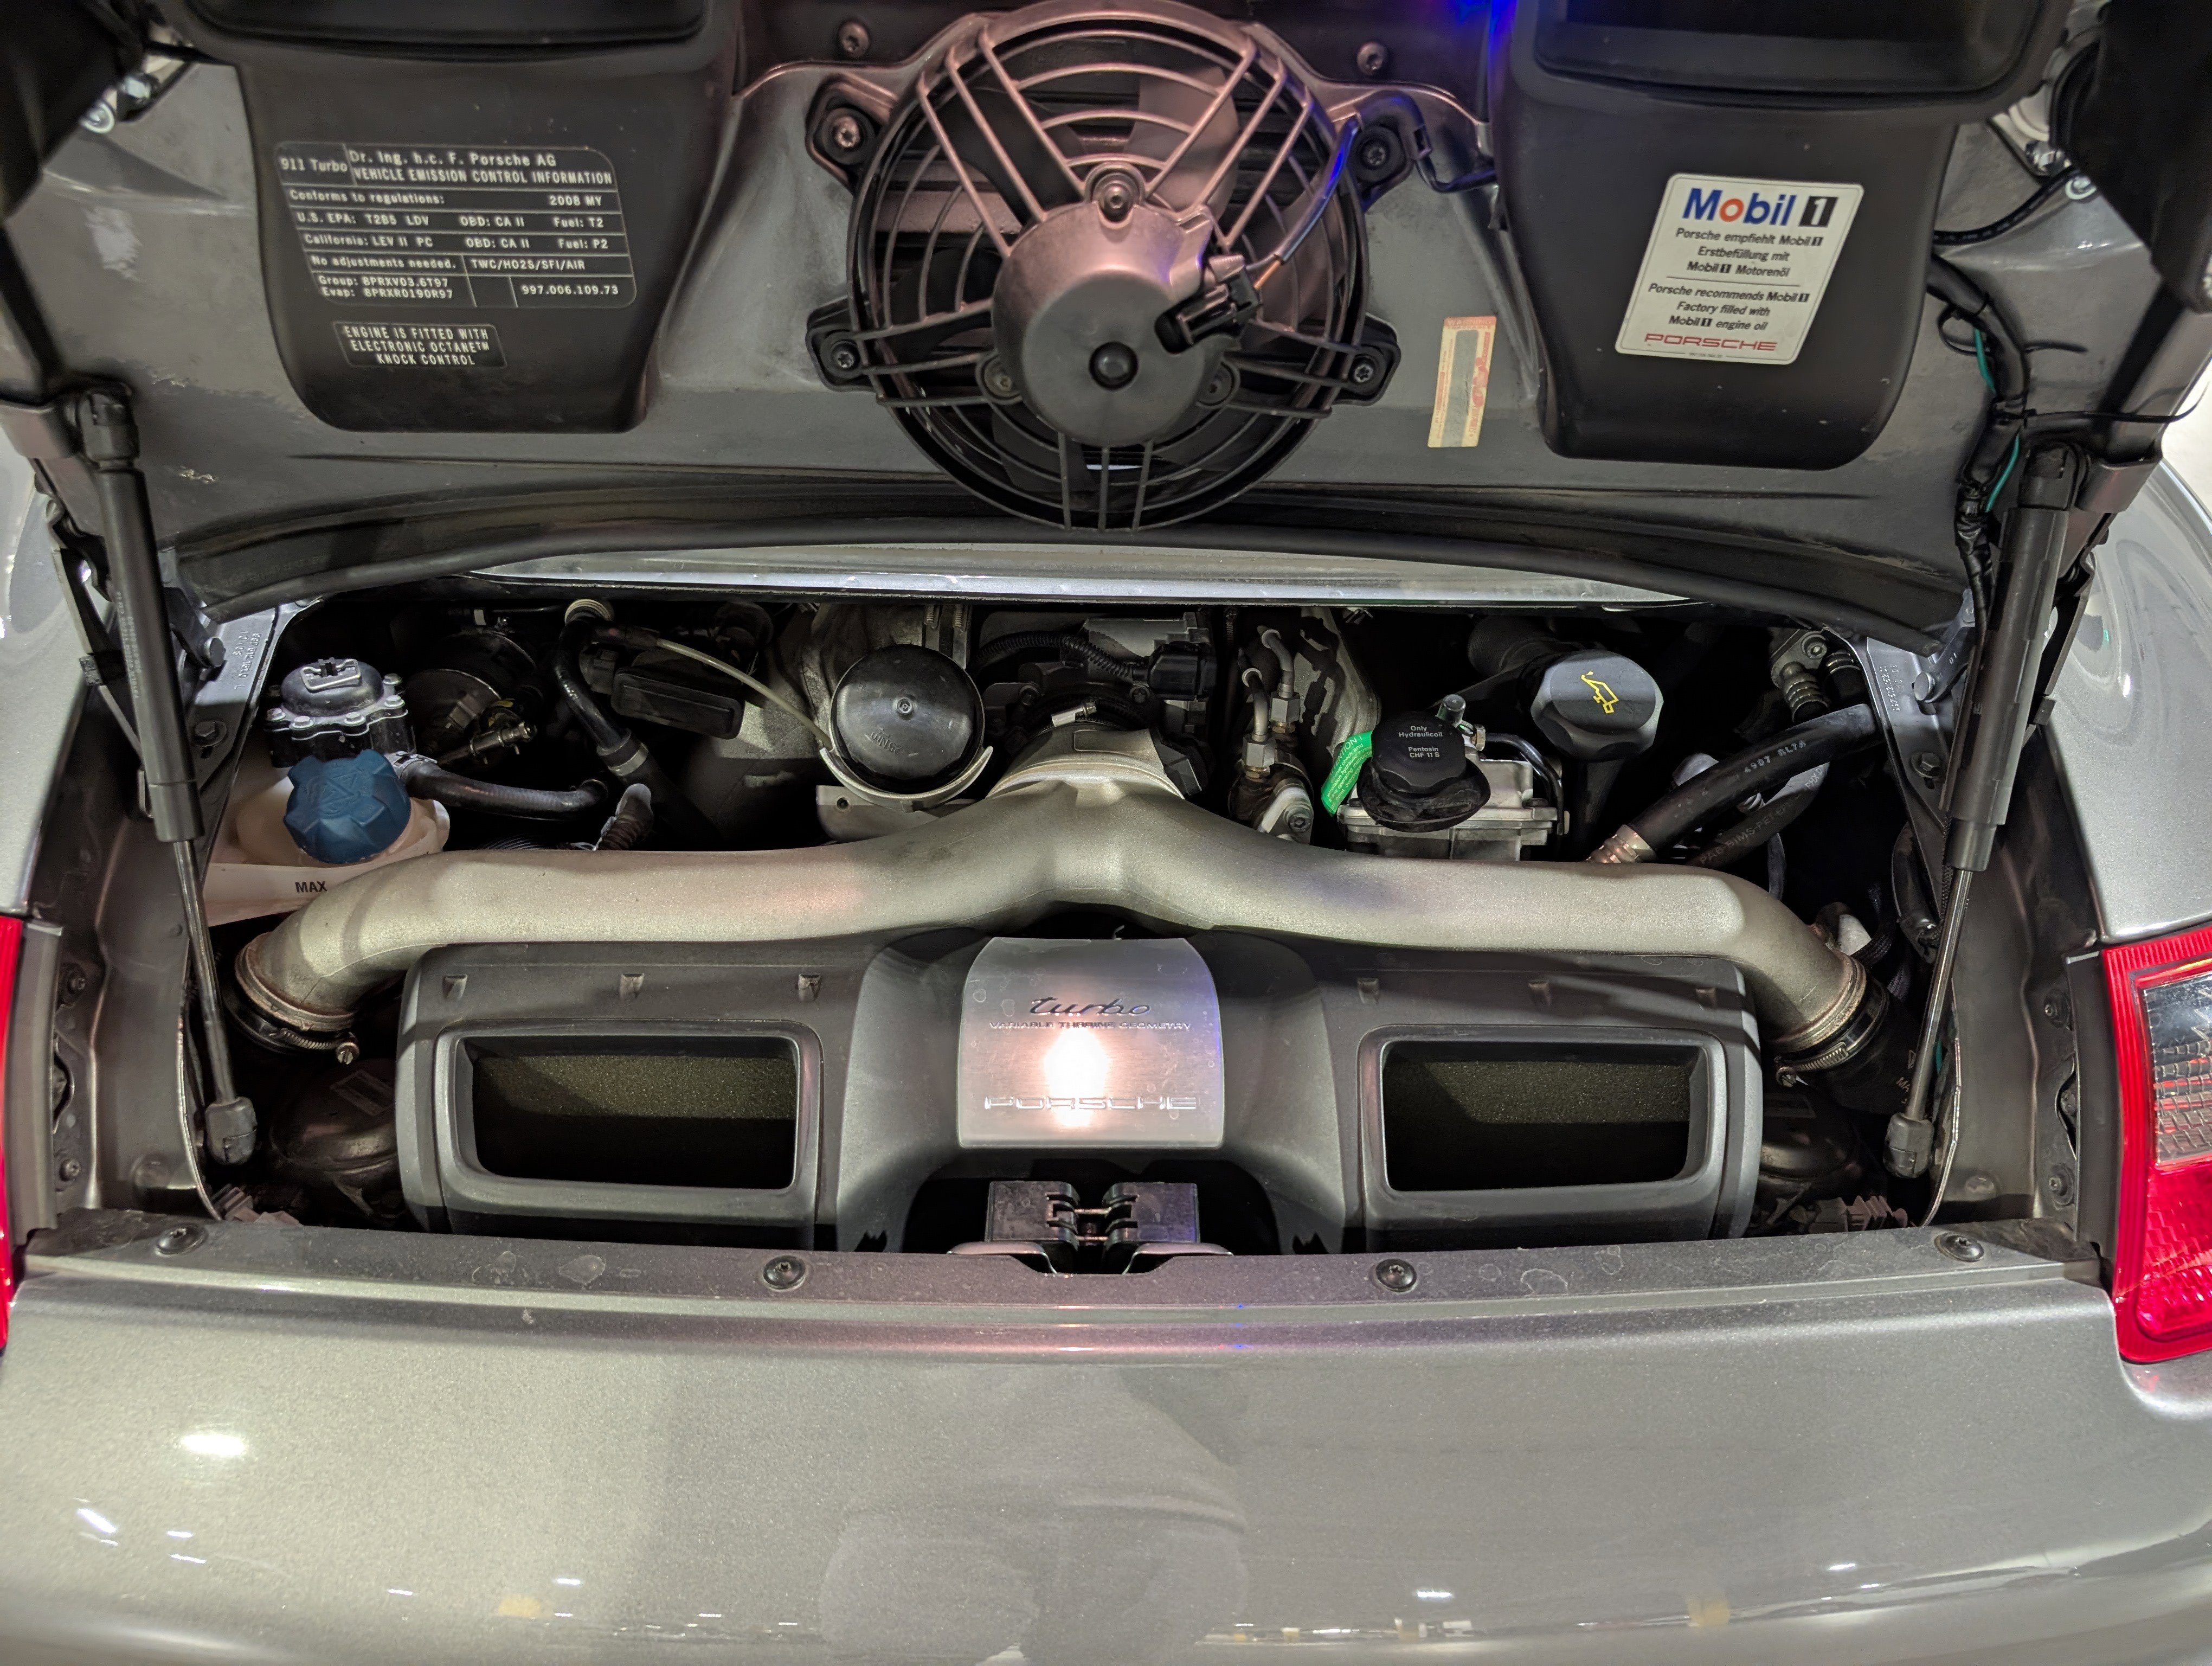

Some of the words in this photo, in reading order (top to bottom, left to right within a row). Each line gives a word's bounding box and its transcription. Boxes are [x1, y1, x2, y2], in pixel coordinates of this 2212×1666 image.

[280, 157, 306, 171] 911
[309, 158, 348, 172] Turbo
[349, 150, 373, 163] Dr.
[376, 151, 407, 166] Ing.
[413, 152, 443, 164] h.c.
[448, 151, 464, 165] F.
[468, 152, 530, 166] Porsche
[536, 154, 557, 167] AG
[353, 168, 405, 181] VEHICLE
[408, 168, 467, 182] EMISSION
[472, 170, 528, 183] CONTROL
[532, 171, 612, 184] INFORMATION
[290, 189, 348, 202] Conforms
[352, 193, 365, 202] to
[371, 193, 445, 205] regulations:
[549, 195, 581, 207] 2008
[584, 195, 602, 207] MY
[1682, 188, 1797, 226] Mobil
[1798, 196, 1838, 227] 1
[297, 212, 324, 223] U.S.
[326, 212, 357, 224] EPA:
[405, 215, 429, 226] LDV
[460, 216, 491, 227] OBD:
[494, 216, 512, 227] CA
[553, 217, 584, 228] Fuel:
[587, 217, 604, 228] T2
[304, 233, 369, 246] California:
[371, 235, 394, 247] LEV
[415, 236, 433, 247] PC
[466, 237, 496, 249] OBD:
[499, 238, 517, 249] CA
[557, 238, 588, 249] Fuel:
[592, 239, 608, 249] P2
[1676, 227, 1721, 241] Porsche
[1724, 233, 1776, 245] empfiehlt
[1779, 235, 1811, 246] Mobil
[311, 255, 328, 266] No
[331, 257, 404, 268] adjustments
[408, 258, 456, 269] needed.
[1698, 246, 1769, 262] Erstbefüllung
[1771, 252, 1790, 261] mit
[1687, 261, 1719, 273] Mobil
[1735, 265, 1791, 277] Motorenöl
[318, 274, 359, 287] Group:
[321, 286, 356, 298] Evap:
[522, 284, 619, 296] 997.006.109.73
[1648, 283, 1693, 296] Porsche
[1695, 289, 1765, 301] recommends
[1766, 292, 1798, 303] Mobil
[1676, 301, 1718, 314] Factory
[1720, 304, 1747, 315] filled
[1749, 307, 1771, 316] with
[1669, 315, 1701, 326] Mobil
[1716, 321, 1751, 331] engine
[1753, 322, 1769, 331] oil
[344, 325, 390, 339] ENGINE
[394, 327, 407, 339] IS
[410, 327, 454, 340] FITTED
[458, 328, 488, 340] WITH
[350, 339, 426, 353] ELECTRONIC
[1644, 333, 1778, 351] PORSCHE
[376, 353, 417, 366] KNOCK
[421, 354, 475, 366] CONTROL
[1353, 743, 1364, 752] and
[1338, 768, 1353, 789] operating
[295, 881, 327, 893] MAX
[1030, 996, 1150, 1016] turbo
[989, 1021, 1054, 1029] VARIABLE
[1118, 1021, 1192, 1031] GEOMETRY
[985, 1096, 1197, 1111] PORSCHE
